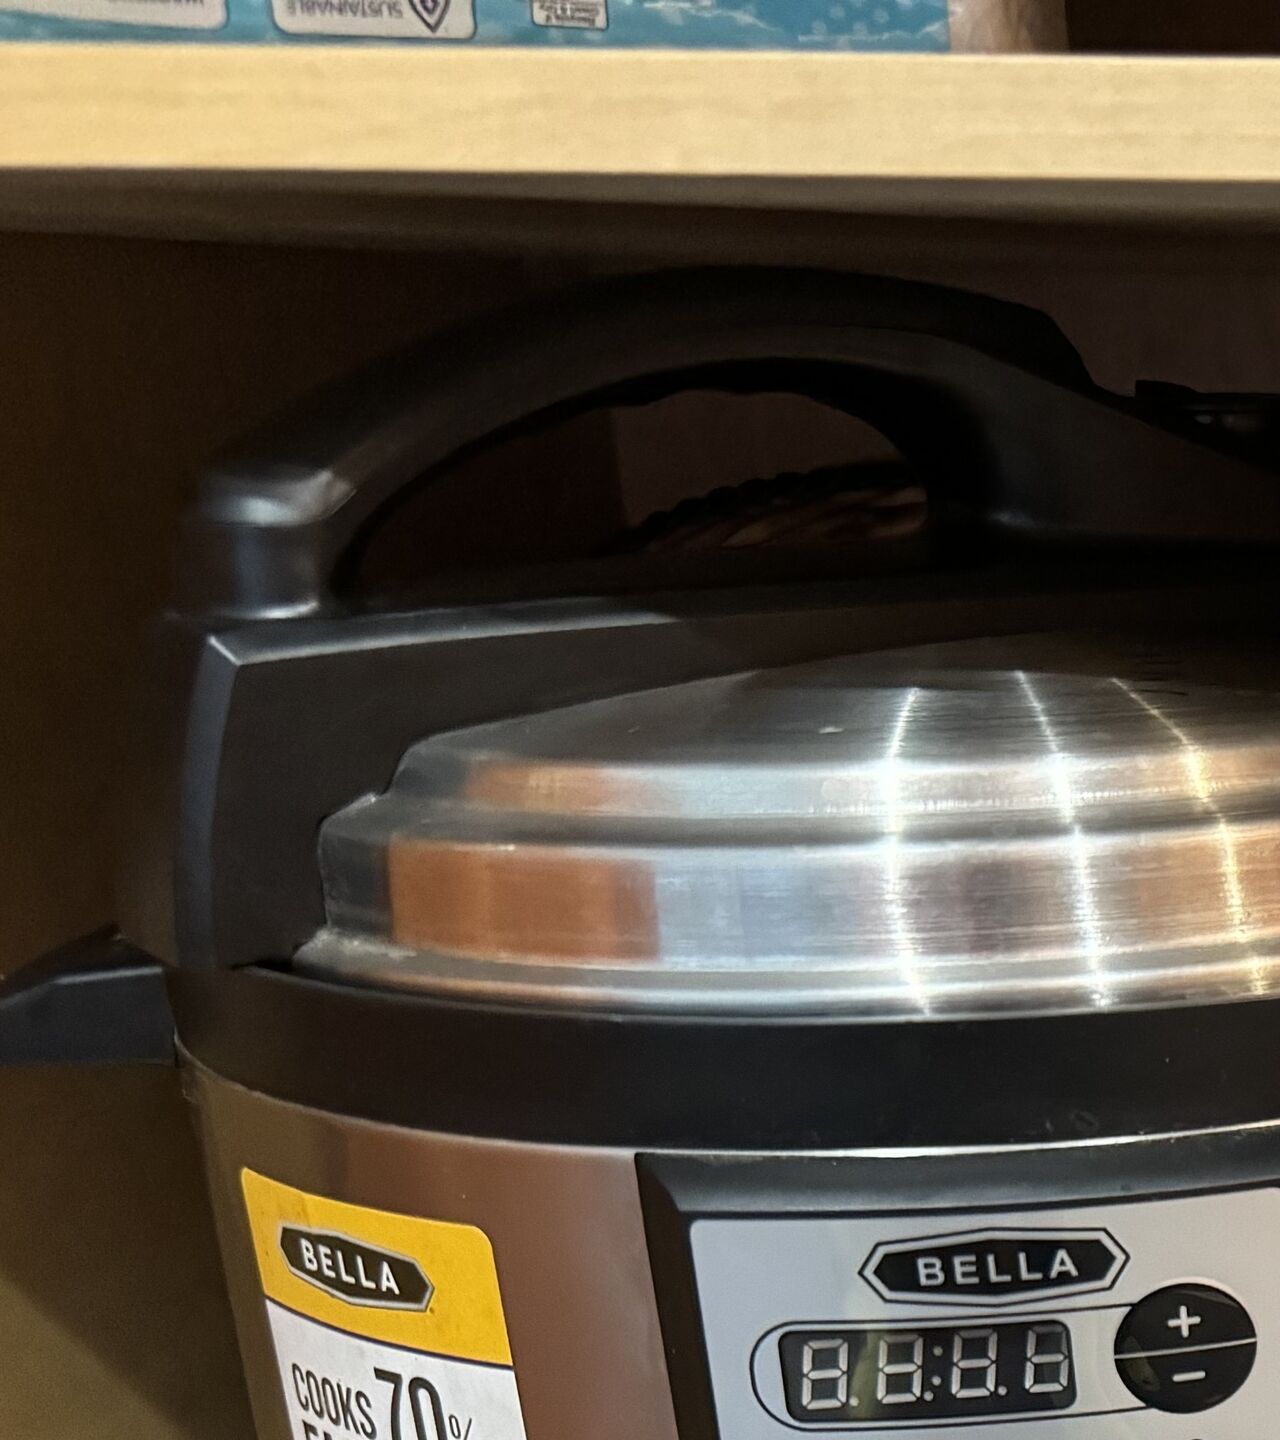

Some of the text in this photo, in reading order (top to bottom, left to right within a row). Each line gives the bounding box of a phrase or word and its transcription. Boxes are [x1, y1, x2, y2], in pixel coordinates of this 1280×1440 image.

[301, 1238, 400, 1296] BELLA
[917, 1249, 1079, 1288] BELLA
[292, 1363, 378, 1440] COOKS
